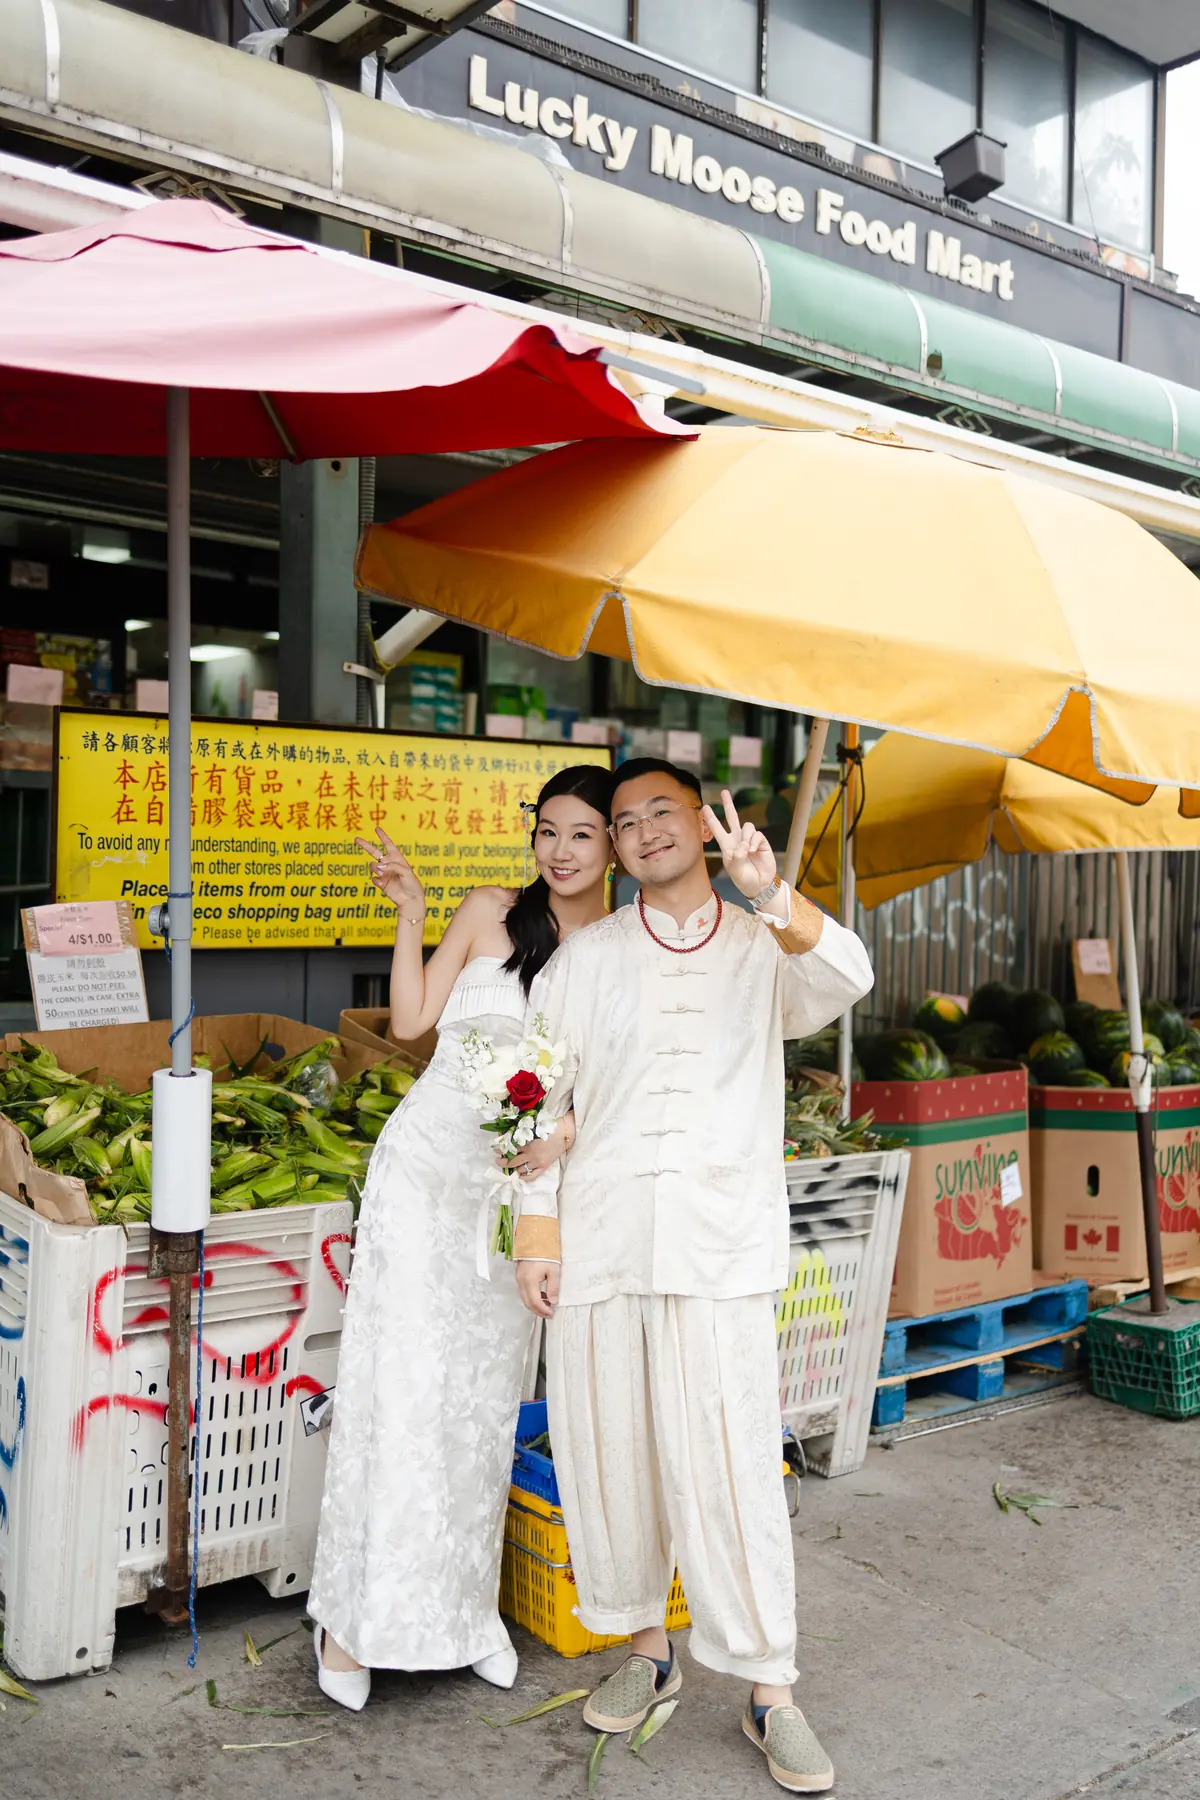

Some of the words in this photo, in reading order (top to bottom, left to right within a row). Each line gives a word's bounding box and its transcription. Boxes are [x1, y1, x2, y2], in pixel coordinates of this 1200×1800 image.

[469, 54, 638, 172] Lucky
[650, 124, 804, 224] Moose
[816, 188, 917, 267] Food
[926, 230, 1014, 301] Mart
[78, 833, 92, 849] To
[98, 834, 132, 850] avoid
[138, 838, 160, 854] any
[283, 841, 300, 854] we
[415, 841, 439, 857] have
[443, 840, 455, 856] all
[458, 845, 481, 860] your
[208, 859, 241, 875] other
[244, 860, 281, 876] stores
[285, 860, 324, 879] placed
[327, 862, 373, 879] securely
[418, 865, 439, 877] own
[443, 865, 462, 877] eco
[464, 863, 511, 881] shopping
[121, 880, 168, 896] Place
[199, 881, 244, 897] items
[249, 881, 285, 897] from
[290, 884, 316, 897] our
[321, 883, 358, 898] store
[363, 882, 376, 897] in
[193, 906, 222, 919] eco
[227, 904, 299, 922] shopping
[304, 904, 332, 922] bag
[337, 904, 369, 918] until
[68, 933, 112, 945] 4/$1.00
[202, 926, 242, 939] Please
[247, 926, 261, 938] be
[265, 927, 309, 938] advised
[314, 926, 335, 938] that
[340, 925, 353, 938] all
[52, 985, 76, 993] PLEASE
[78, 984, 90, 992] DO
[91, 983, 107, 991] NOT
[109, 982, 126, 990] PEEL
[40, 997, 54, 1005] THE
[116, 992, 140, 1000] EXTRA
[77, 1007, 99, 1017] (EACH
[122, 1005, 140, 1013] WILL
[69, 1020, 80, 1028] BE
